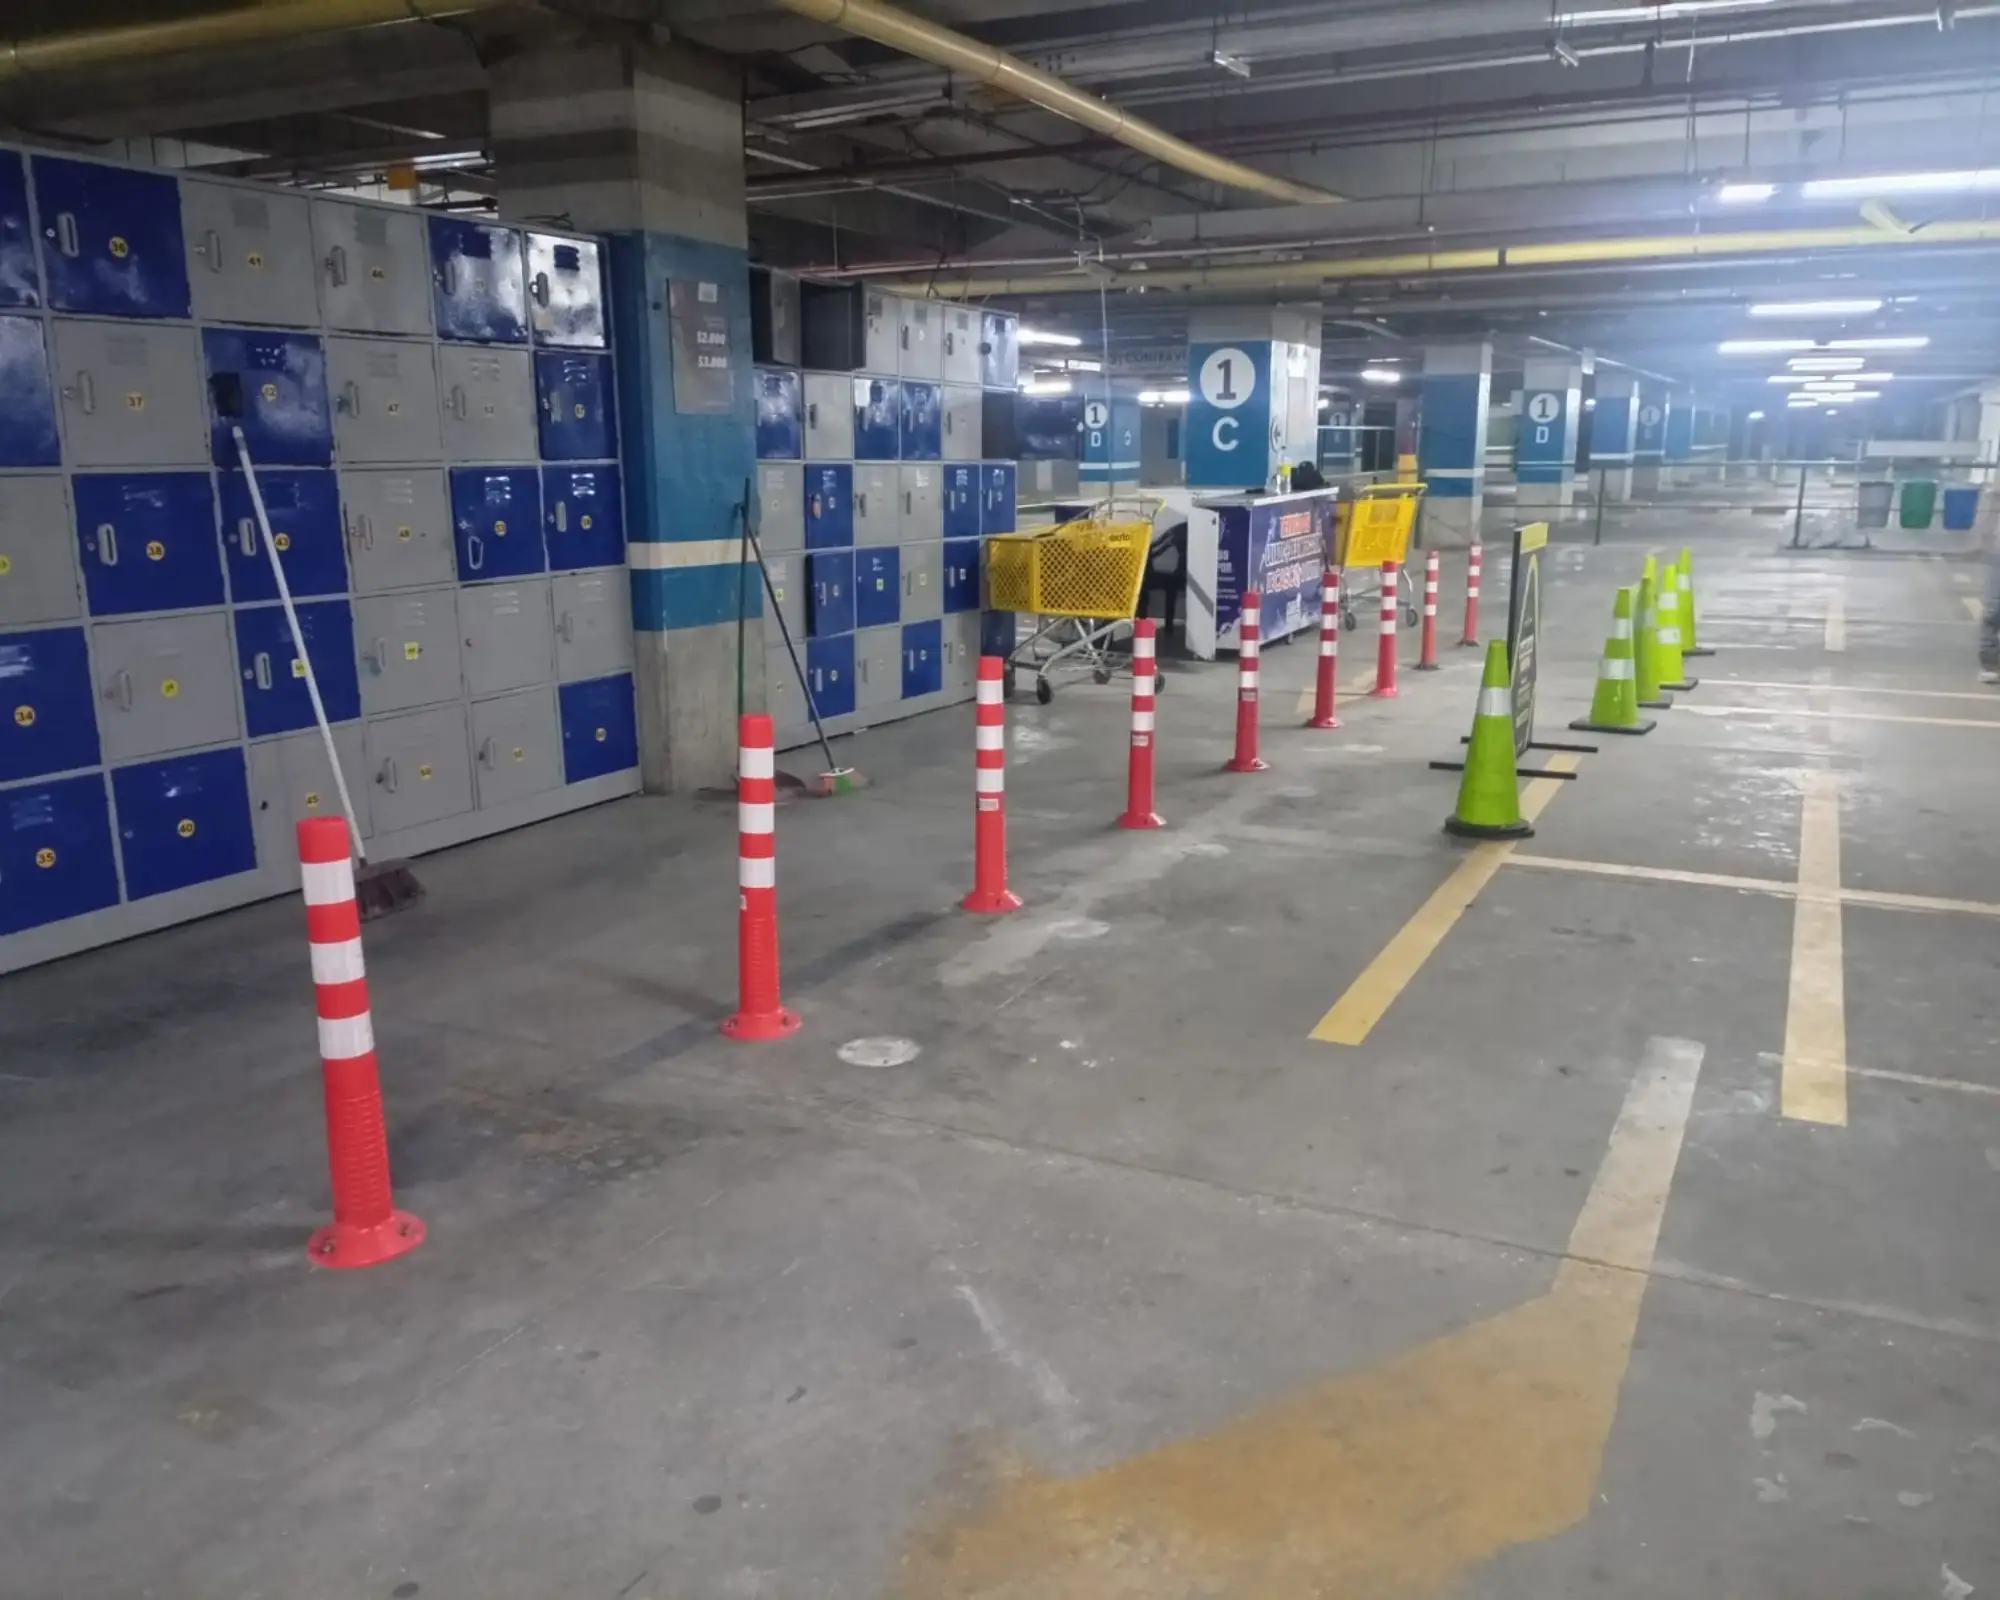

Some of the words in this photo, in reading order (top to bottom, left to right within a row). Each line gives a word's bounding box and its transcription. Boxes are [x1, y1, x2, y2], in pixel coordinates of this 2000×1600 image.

[1216, 357, 1237, 401] 1
[1090, 406, 1101, 424] 1
[1537, 396, 1550, 419] 1
[1646, 409, 1655, 424] 1
[1090, 431, 1102, 448] D
[1212, 416, 1240, 452] C
[1536, 426, 1549, 444] D
[180, 824, 193, 834] 40
[37, 853, 54, 864] 35
